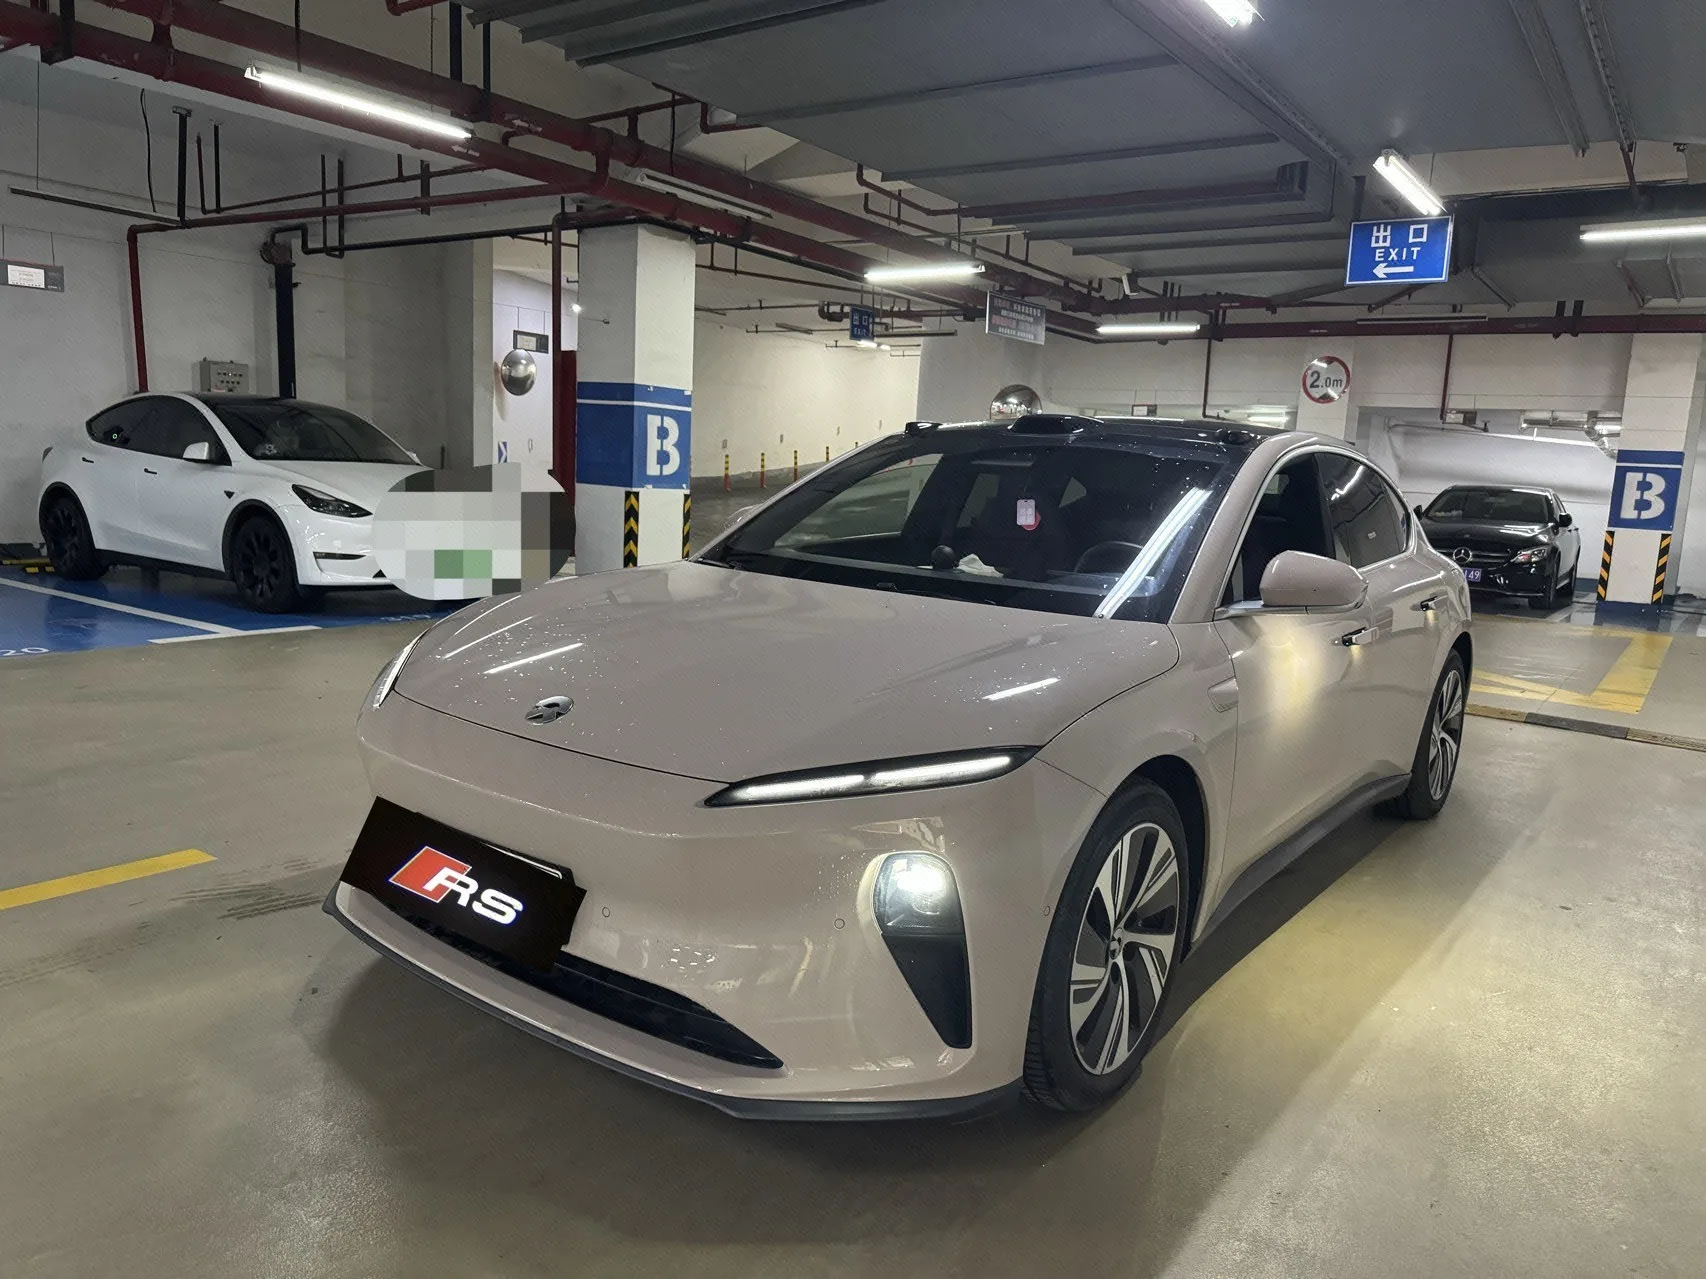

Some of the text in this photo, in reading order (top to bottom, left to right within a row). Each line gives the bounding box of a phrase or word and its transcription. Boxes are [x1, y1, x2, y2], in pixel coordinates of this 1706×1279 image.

[1371, 224, 1428, 247] 出口
[1375, 247, 1421, 261] EXIT
[1309, 370, 1343, 389] 2.0m
[646, 414, 681, 476] B
[1620, 471, 1666, 520] B
[422, 866, 524, 925] RS
